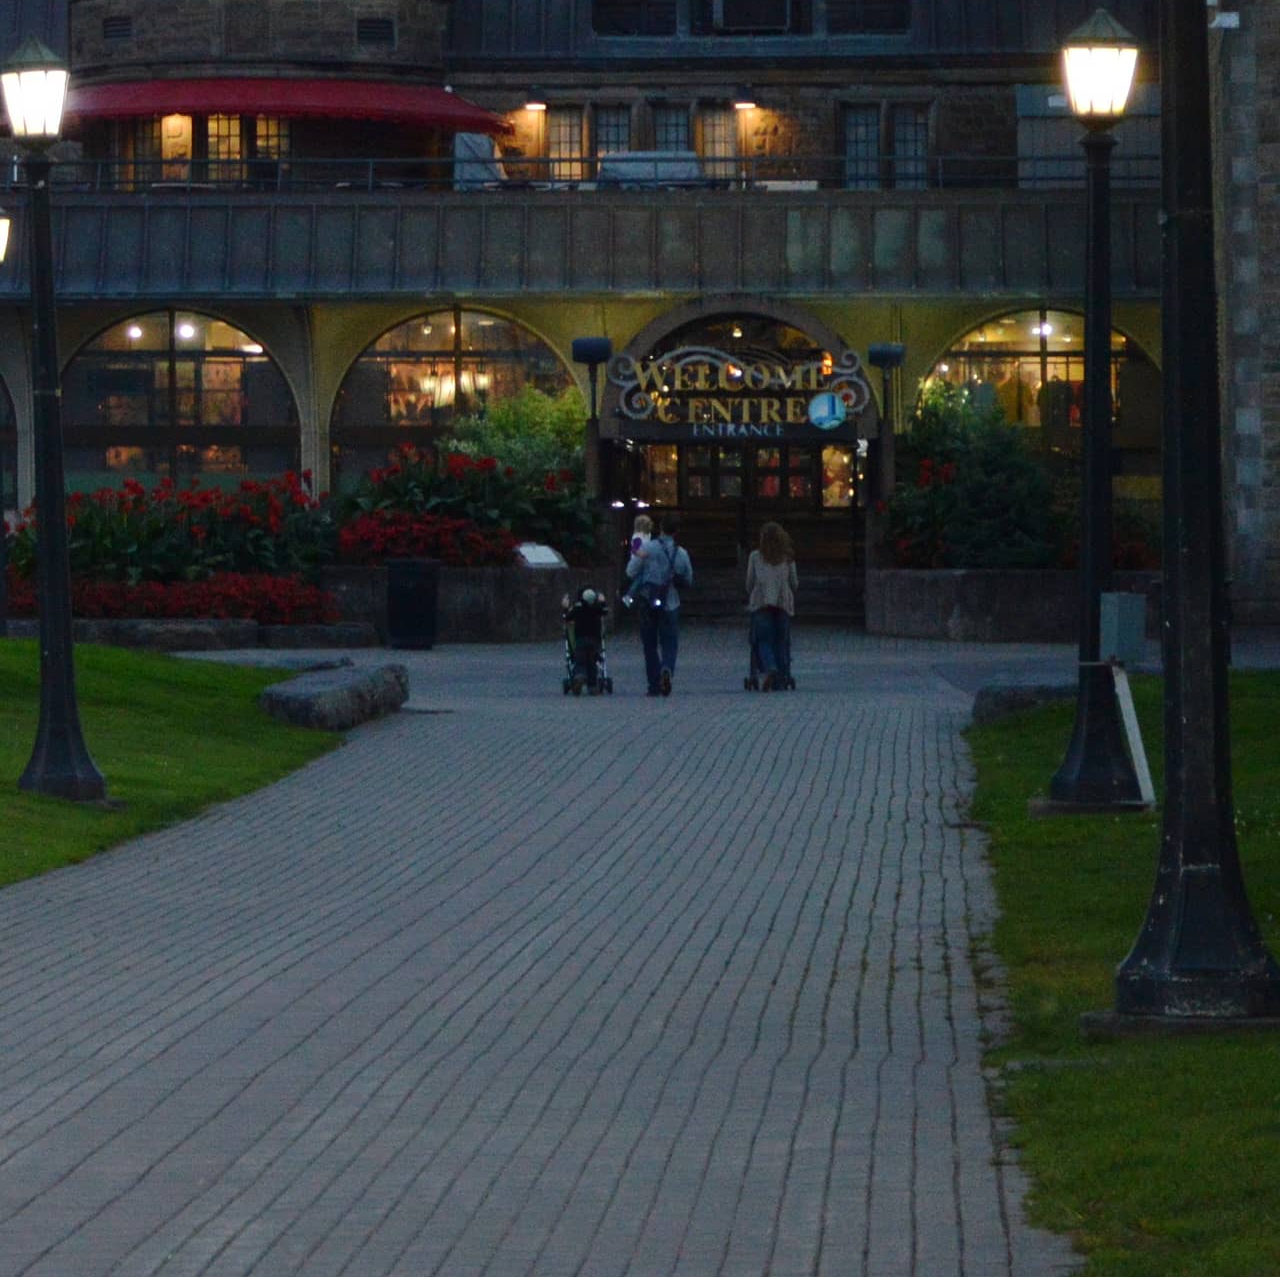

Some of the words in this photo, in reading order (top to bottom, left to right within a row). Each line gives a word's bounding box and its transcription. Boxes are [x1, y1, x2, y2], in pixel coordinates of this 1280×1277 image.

[634, 362, 830, 391] WELCOME
[654, 397, 807, 423] CENTRE
[693, 424, 784, 436] ENTRANCE
